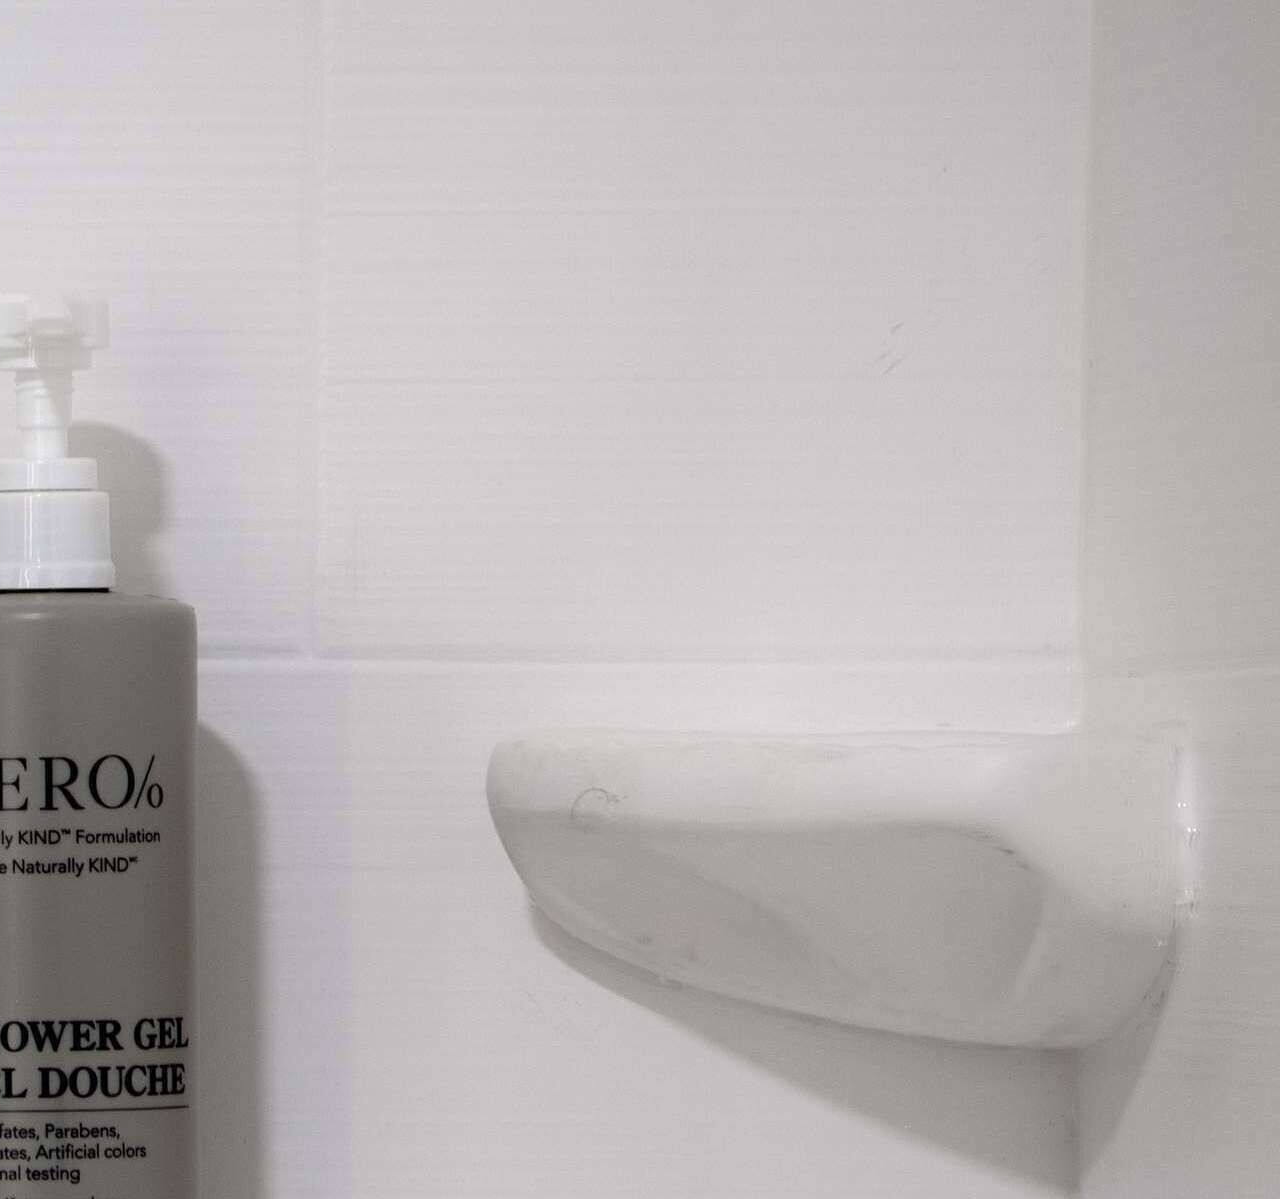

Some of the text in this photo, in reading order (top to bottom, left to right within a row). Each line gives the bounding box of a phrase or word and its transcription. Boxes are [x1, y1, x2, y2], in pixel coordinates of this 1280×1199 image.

[76, 828, 160, 844] Formulation
[12, 860, 84, 877] Naturally
[133, 1017, 189, 1050] GEL
[38, 1063, 186, 1098] DOUCHE
[45, 1123, 120, 1139] Parabens,
[35, 1143, 100, 1159] Artificial
[104, 1142, 147, 1158] colors
[26, 1166, 81, 1184] testing
